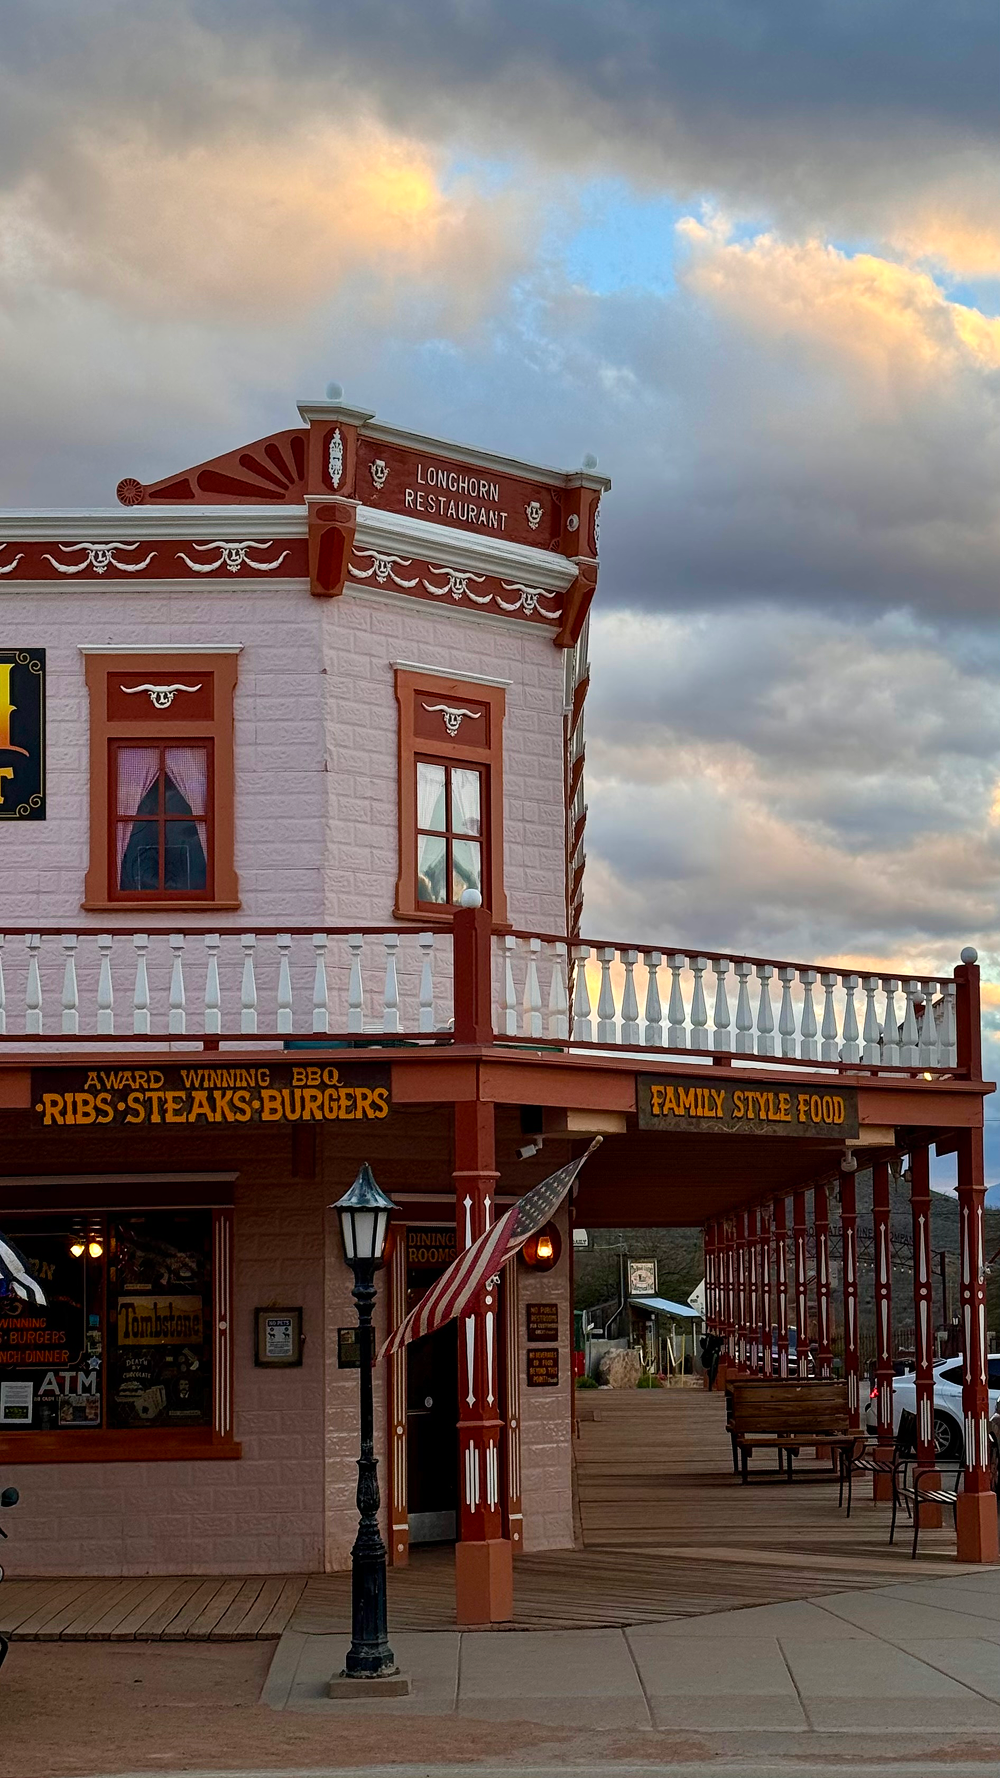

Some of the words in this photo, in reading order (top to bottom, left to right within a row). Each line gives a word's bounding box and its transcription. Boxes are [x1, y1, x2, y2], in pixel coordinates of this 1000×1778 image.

[417, 464, 499, 502] LONGHORN
[405, 488, 508, 531] RESTAURANT
[84, 1070, 164, 1090] AWARD
[180, 1068, 270, 1088] WINNING
[292, 1066, 344, 1087] BBQ
[43, 1092, 114, 1125] RIBS
[124, 1090, 252, 1124] STEAKS
[261, 1088, 390, 1122] BURGERS
[650, 1085, 726, 1118] FAMILY
[732, 1091, 792, 1122] STYLE
[797, 1094, 846, 1124] FOOD
[408, 1232, 455, 1246] DINING
[408, 1248, 456, 1262] ROOMS
[0, 1318, 46, 1328] WINNING
[118, 1302, 200, 1338] Tombstone
[10, 1331, 66, 1344] BURGERS
[26, 1350, 70, 1363] DINNER
[126, 1358, 148, 1367] DEATH
[38, 1371, 97, 1396] ATM
[122, 1371, 152, 1379] CHOCOLATE
